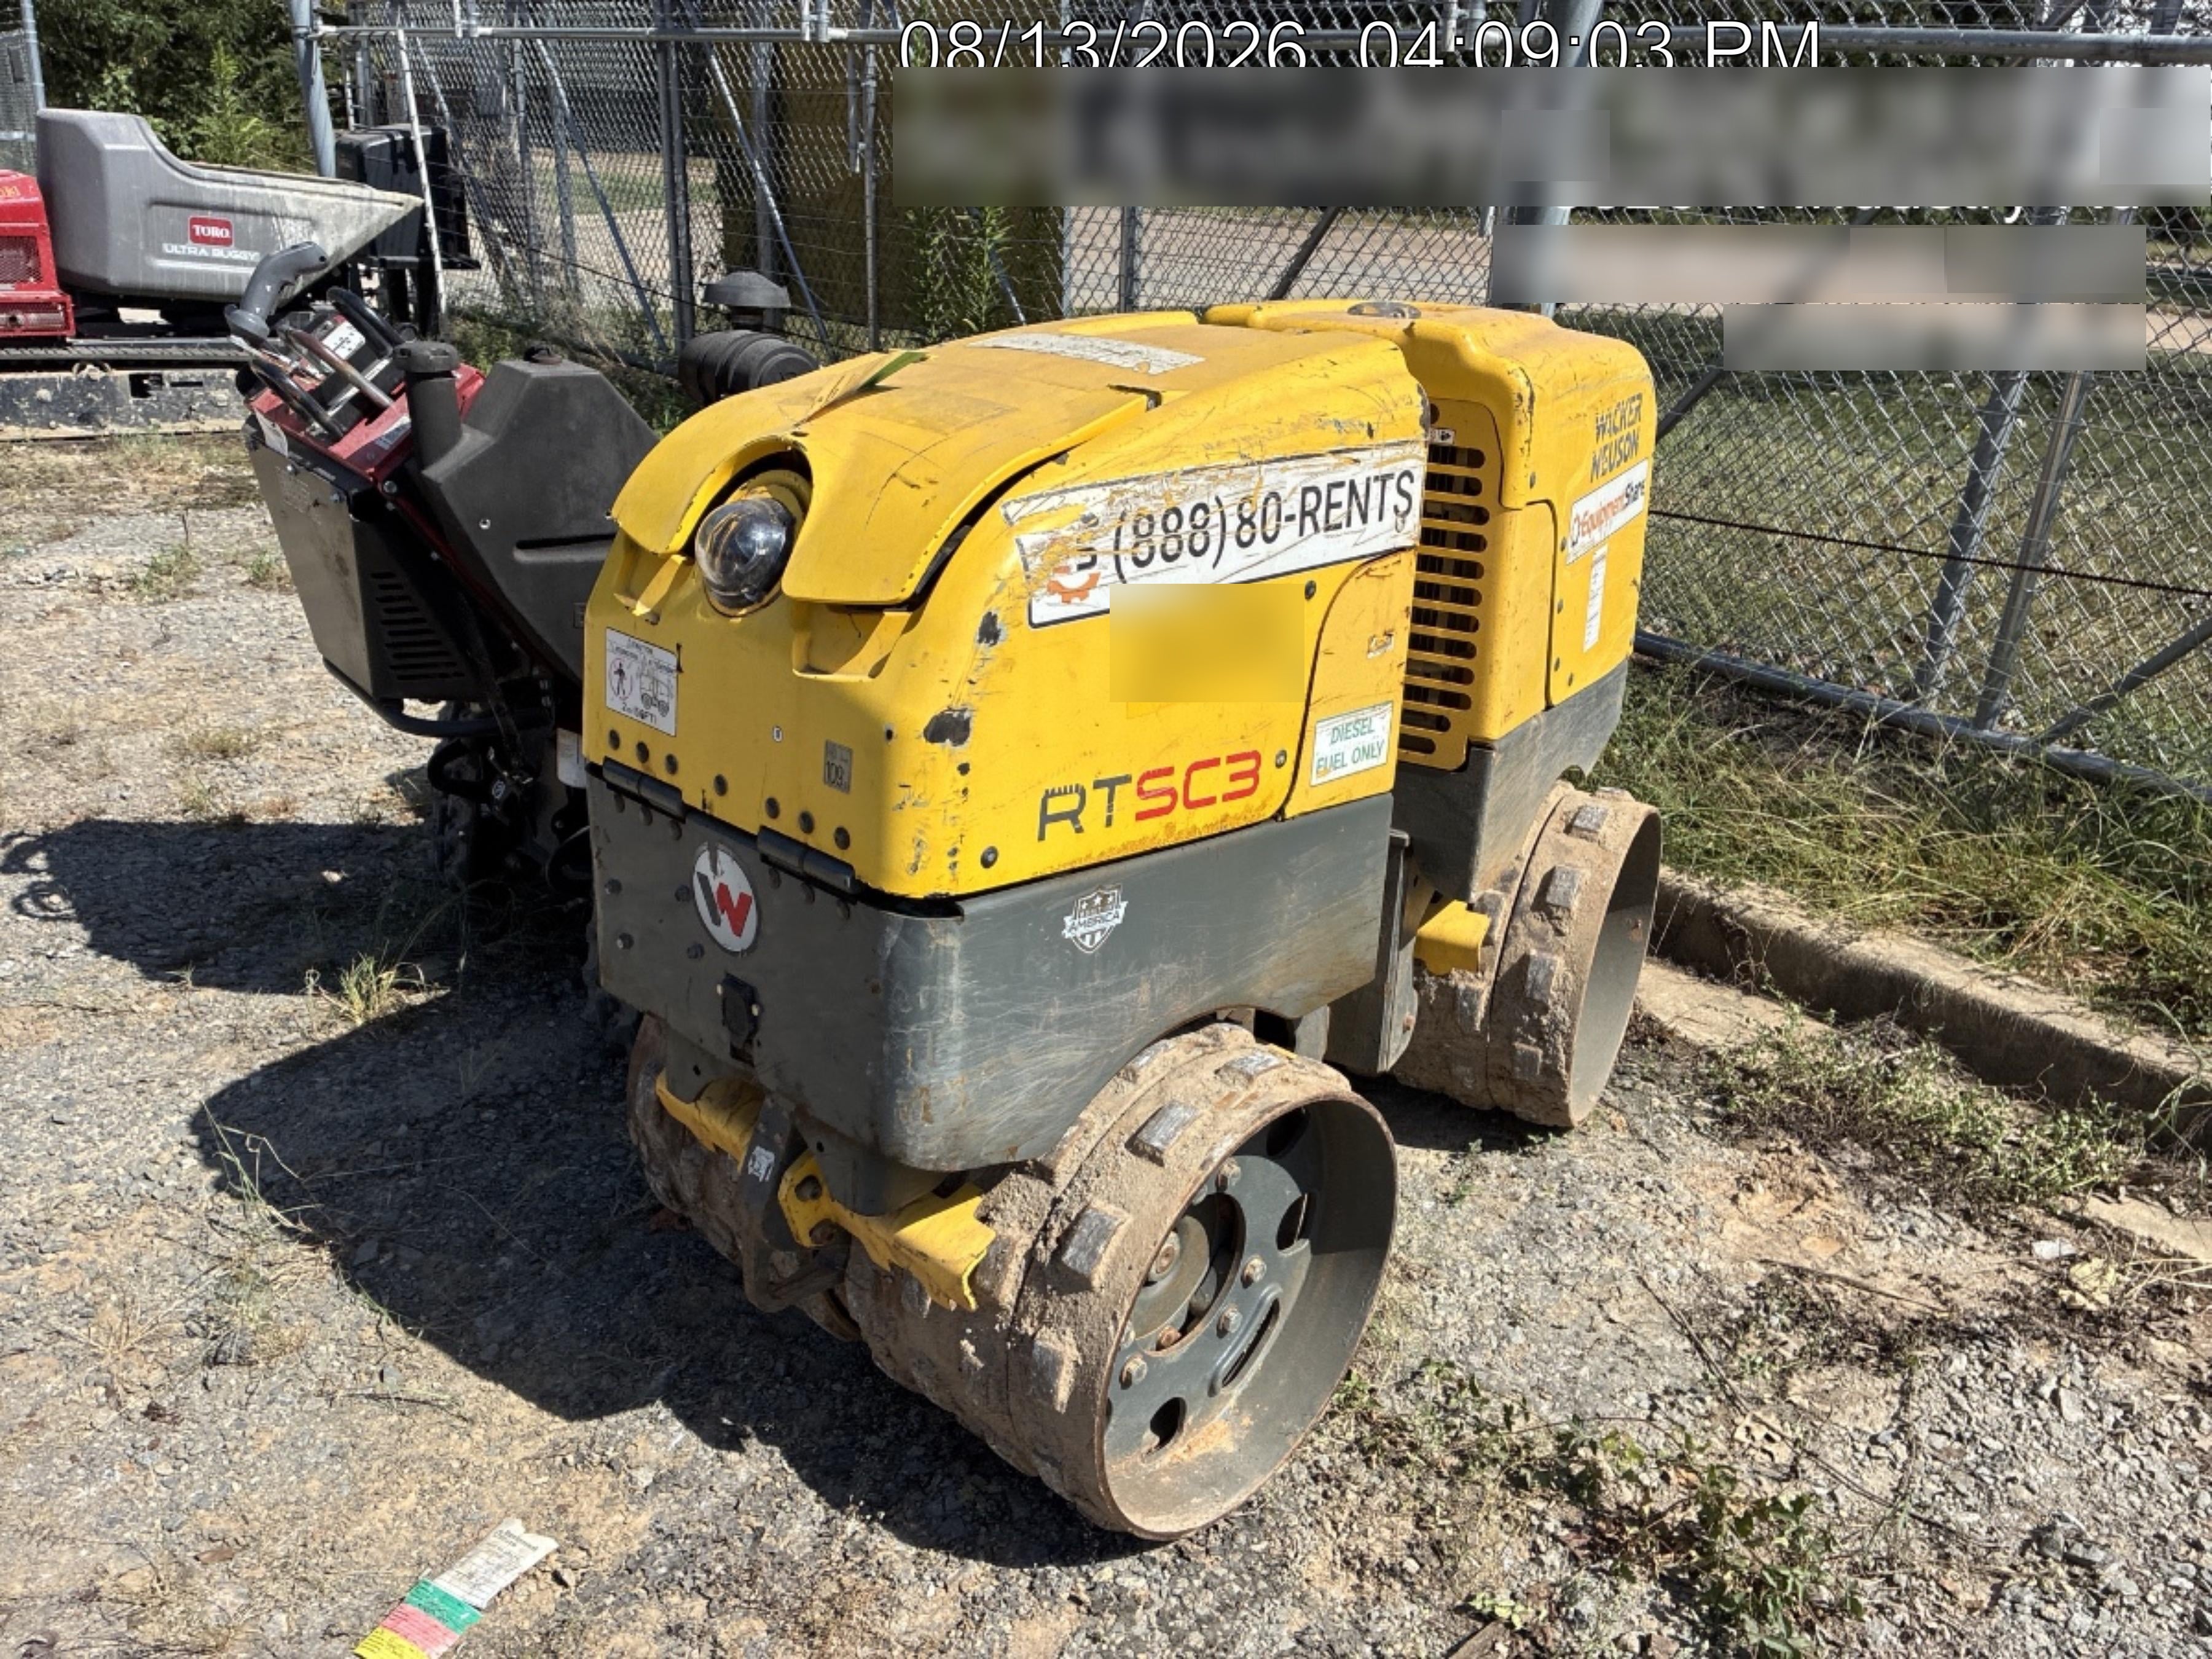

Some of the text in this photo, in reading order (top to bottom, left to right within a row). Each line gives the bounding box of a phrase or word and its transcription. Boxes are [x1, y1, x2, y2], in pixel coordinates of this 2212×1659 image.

[192, 224, 231, 238] TORO
[162, 243, 209, 257] ULTRA
[1590, 426, 1640, 484] NEUSON
[1330, 716, 1375, 746] DIESEL
[1316, 739, 1384, 776] FUEL ONLY
[1037, 750, 1262, 842] RTSC3
